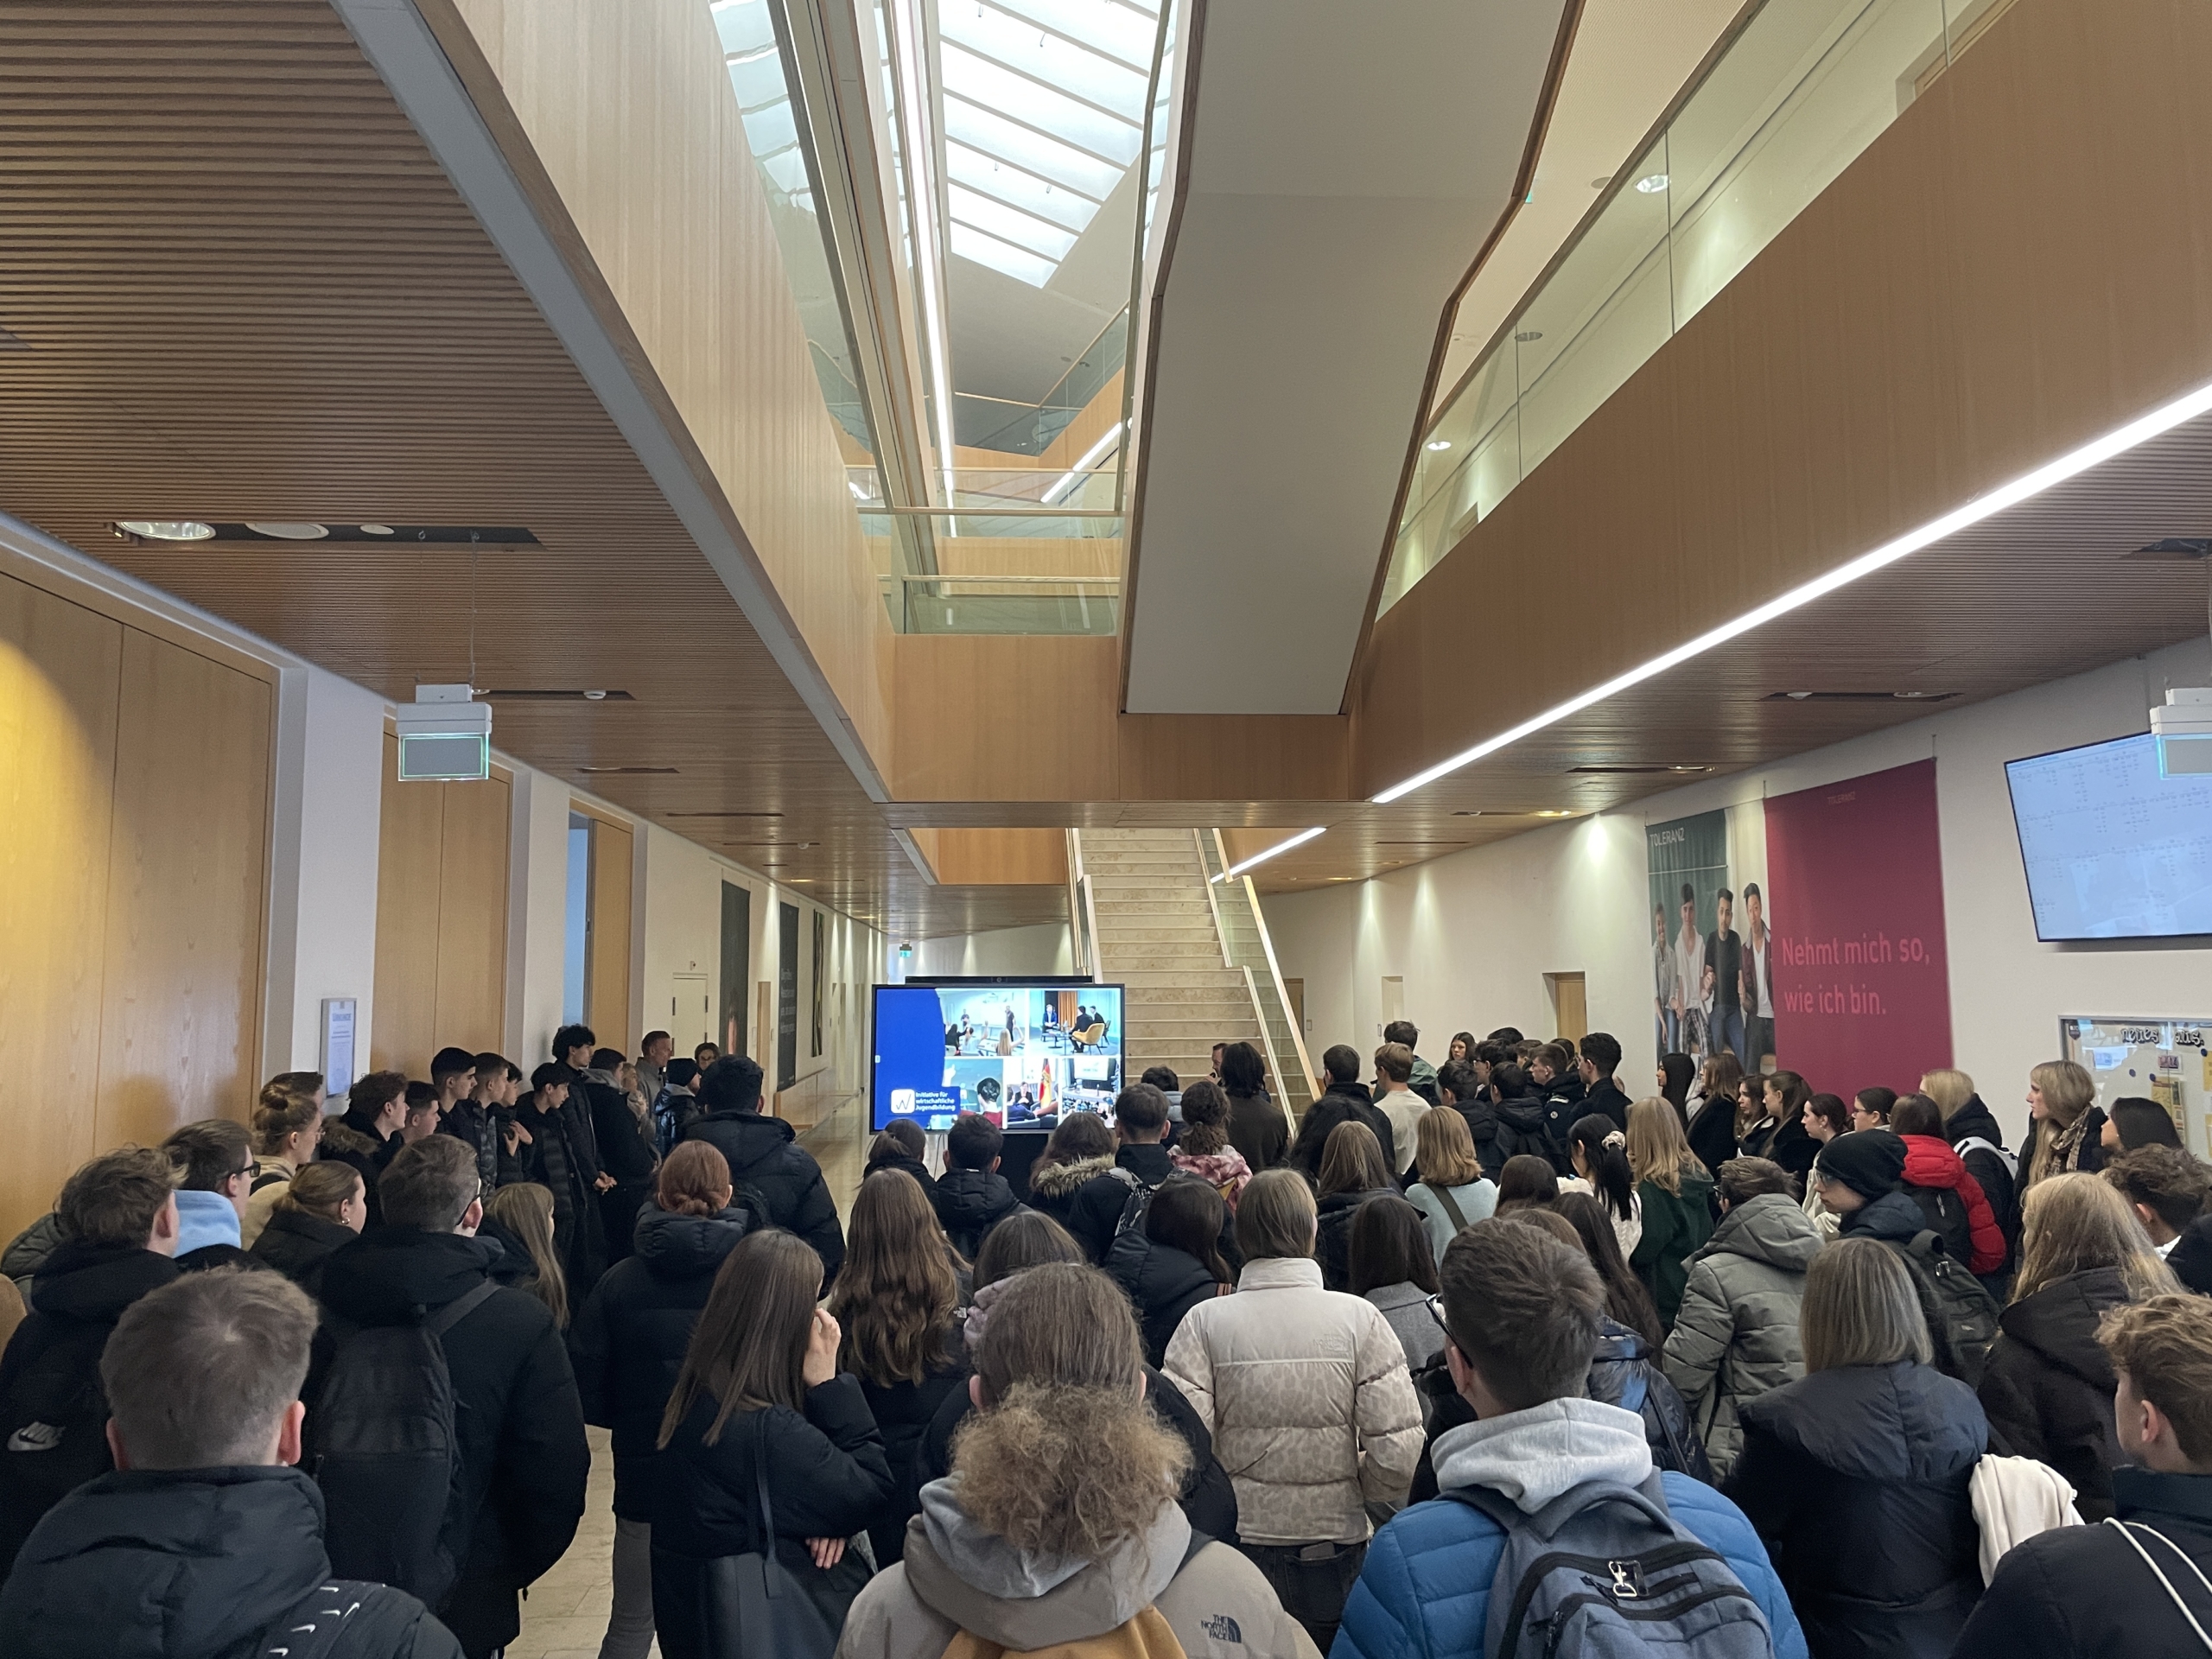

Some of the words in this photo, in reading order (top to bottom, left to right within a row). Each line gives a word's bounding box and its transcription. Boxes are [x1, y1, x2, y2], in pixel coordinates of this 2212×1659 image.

[1649, 827, 1685, 847] TOLERANZ
[1782, 936, 1840, 966] Nehmt
[1844, 931, 1891, 964] mich
[1898, 937, 1929, 965] so,
[1784, 983, 1814, 1014] wie
[1819, 983, 1846, 1014] ich
[1850, 983, 1886, 1014] bin.
[2120, 1027, 2160, 1045] neues
